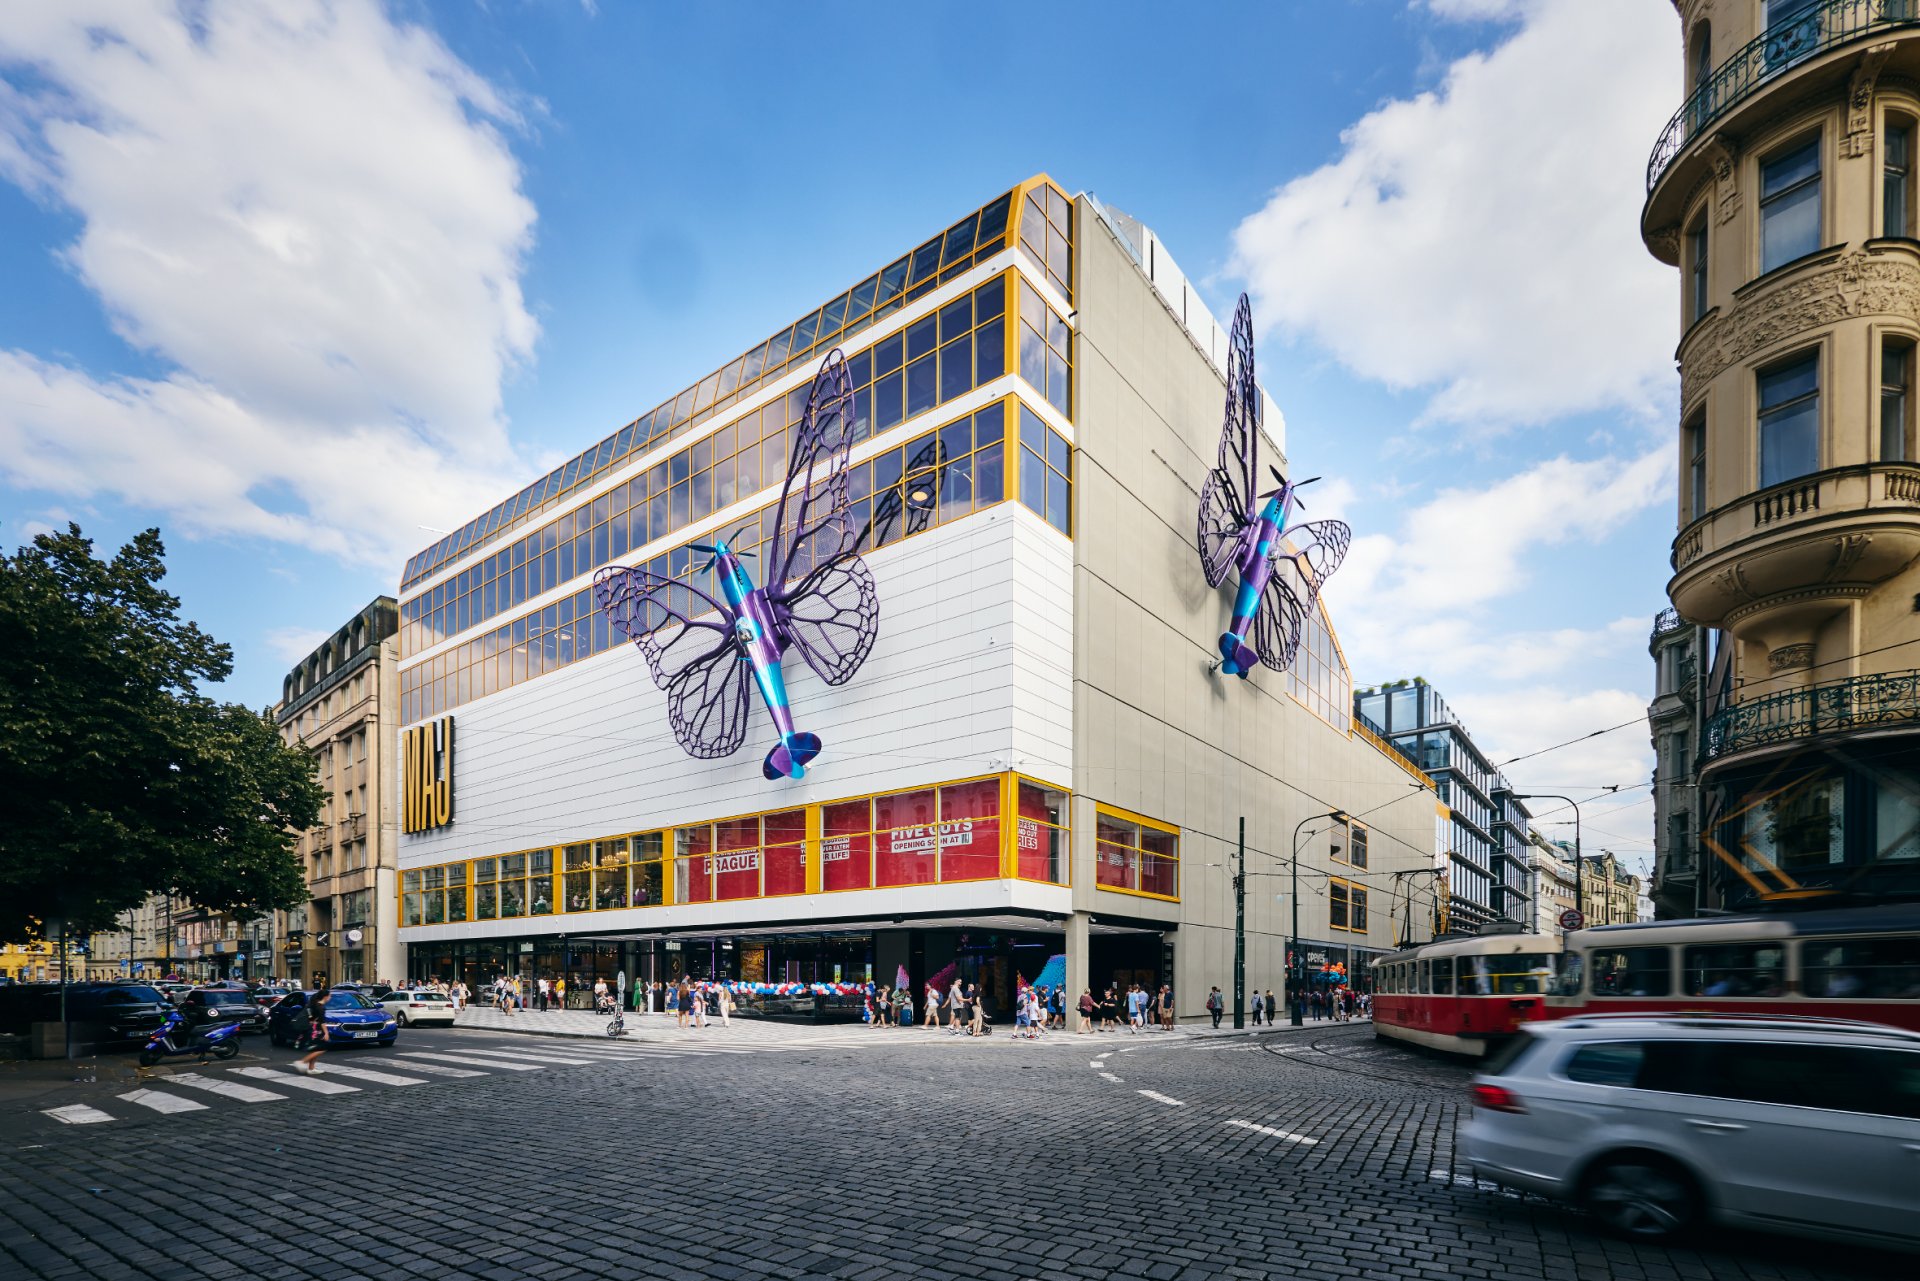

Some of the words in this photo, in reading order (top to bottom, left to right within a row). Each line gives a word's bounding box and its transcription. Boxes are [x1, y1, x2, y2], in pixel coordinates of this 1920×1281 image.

[402, 716, 453, 834] MAJ
[892, 824, 924, 840] FIVE
[894, 840, 926, 850] OPENING
[1018, 836, 1036, 848] RIES
